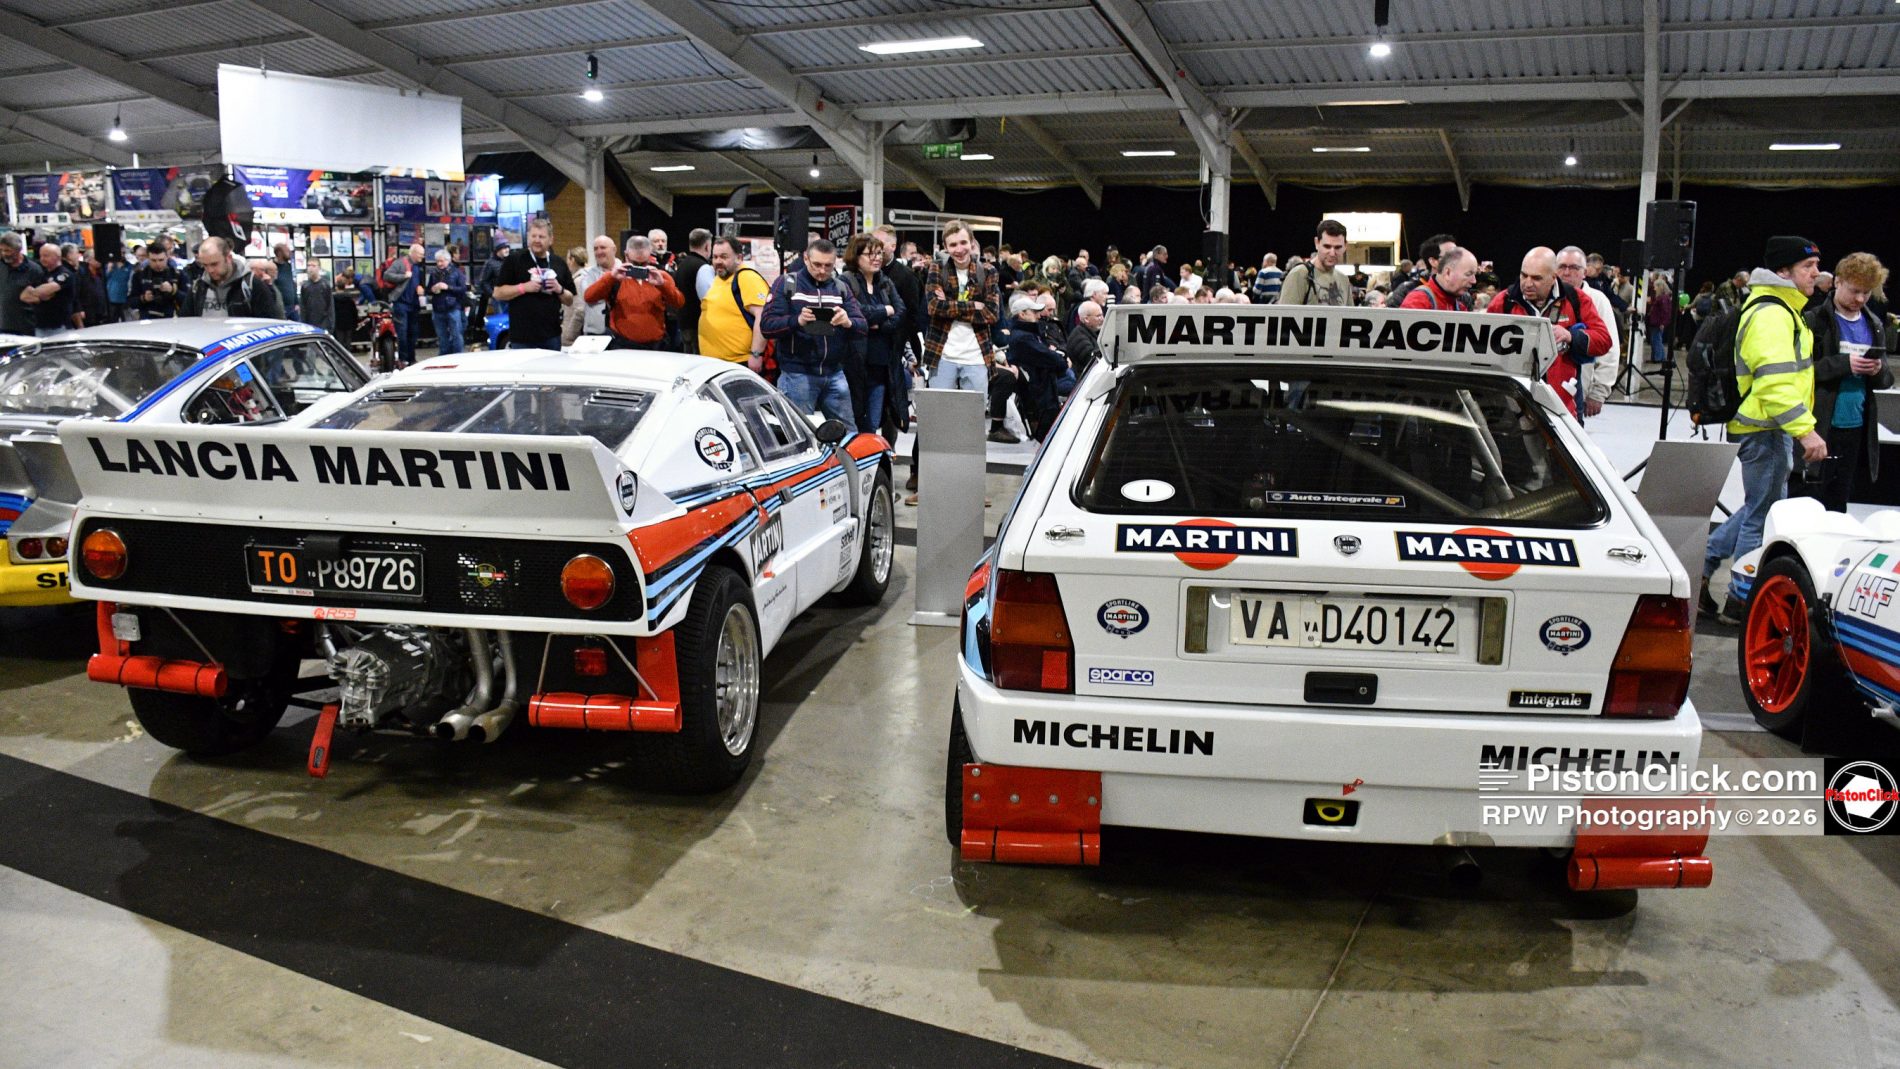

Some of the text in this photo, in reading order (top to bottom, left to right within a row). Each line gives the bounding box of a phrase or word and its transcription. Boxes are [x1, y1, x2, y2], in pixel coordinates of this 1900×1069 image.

[385, 194, 424, 205] POSTERS
[828, 210, 849, 229] BEEF
[829, 224, 850, 241] ONION
[220, 327, 273, 351] MARTINI
[1127, 314, 1525, 356] MARTINI RACING
[87, 437, 570, 491] LANCIA MARTINI
[1289, 493, 1321, 502] Auto
[1323, 494, 1383, 505] Integrale
[1125, 528, 1289, 552] MARTINI
[1405, 536, 1571, 562] MARTINI
[258, 551, 297, 584] TO
[317, 556, 415, 591] P89726
[1105, 600, 1139, 610] SPORTLINE
[1106, 613, 1138, 621] MARTINI
[1241, 600, 1456, 648] VA VA D40142
[1549, 616, 1583, 626] SPORTLINE
[1549, 630, 1581, 638] MARTINI
[1090, 668, 1153, 684] sparco
[1519, 692, 1582, 708] integrale
[1013, 719, 1215, 756] MICHELIN
[1479, 744, 1681, 776] MICHELIN
